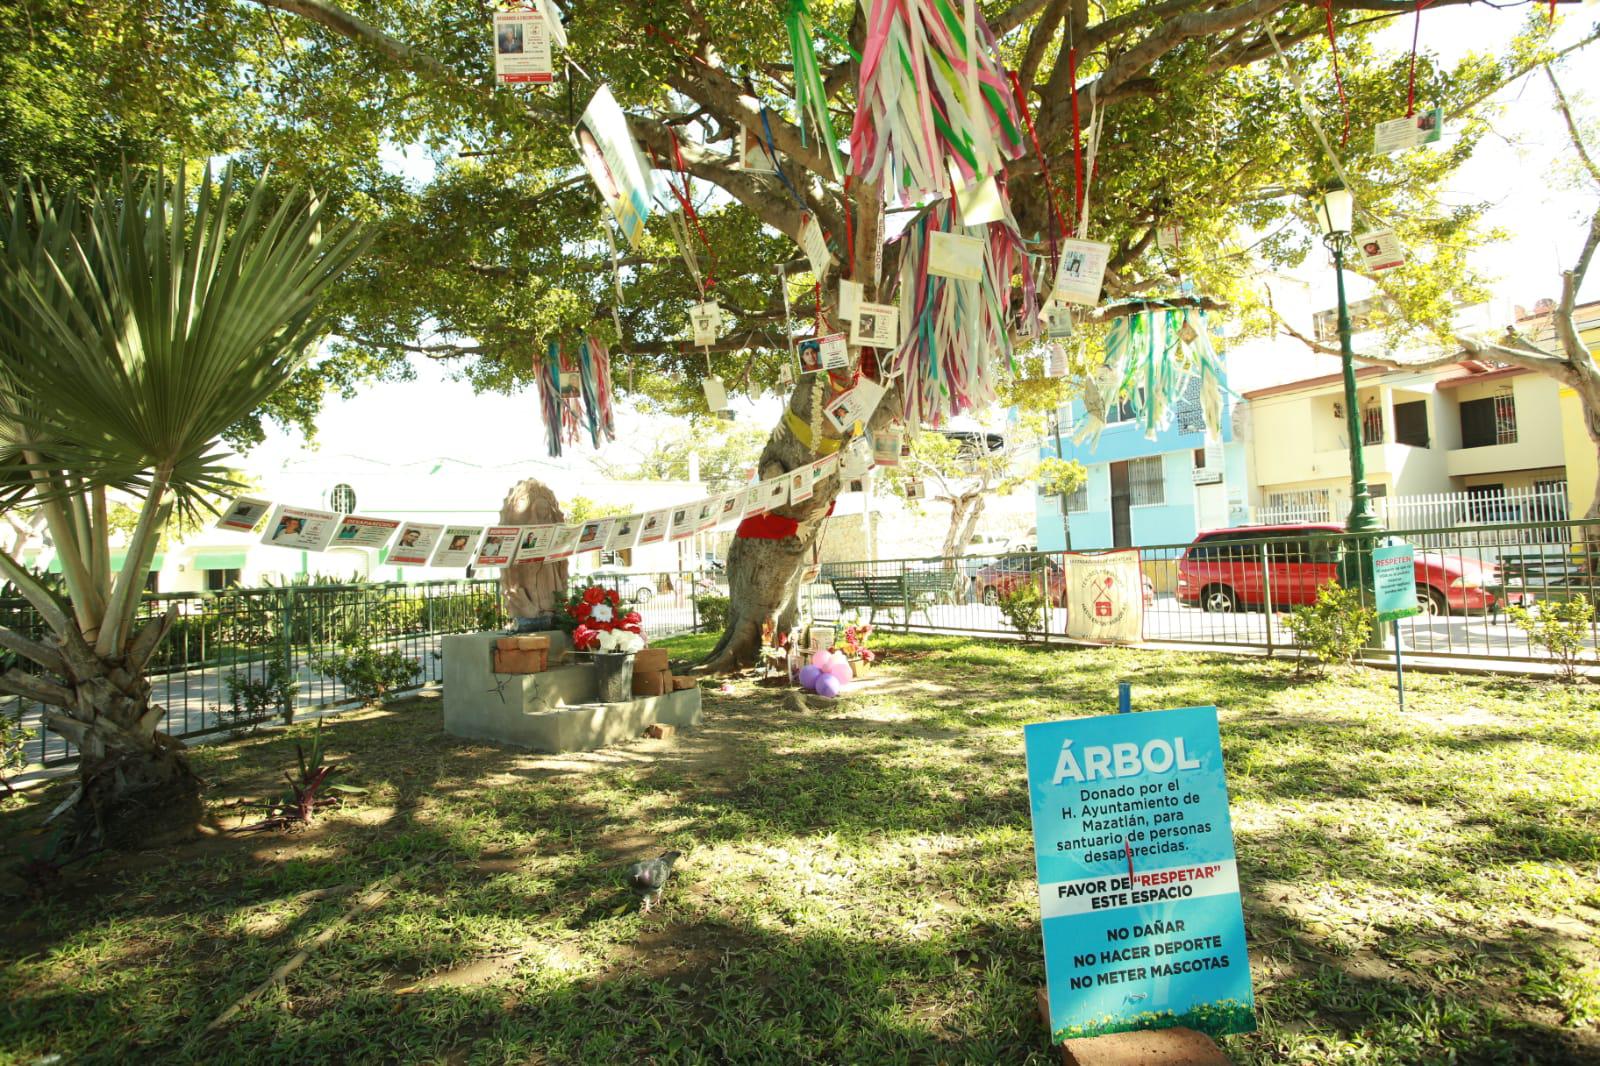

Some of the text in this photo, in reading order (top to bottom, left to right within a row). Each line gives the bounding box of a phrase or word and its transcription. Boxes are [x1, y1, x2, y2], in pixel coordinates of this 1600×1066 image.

[1376, 557, 1411, 567] RESPETEN
[1053, 738, 1200, 785] ÁRBOL
[1081, 779, 1179, 802] Donado por el
[1062, 793, 1200, 819] H. Ayuntamiento de
[1083, 811, 1184, 832] Mazatlán, para
[1057, 822, 1211, 851] santuario de personas
[1084, 841, 1189, 863] desaparecidas.
[1058, 865, 1221, 898] FAVOR DE “RESPETAR”
[1091, 885, 1193, 909] ESTE ESPACIO
[1107, 920, 1185, 942] NO DAÑAR
[1074, 935, 1222, 968] NO HACER DEPORTE
[1070, 955, 1230, 990] NO METER MASCOTAS
